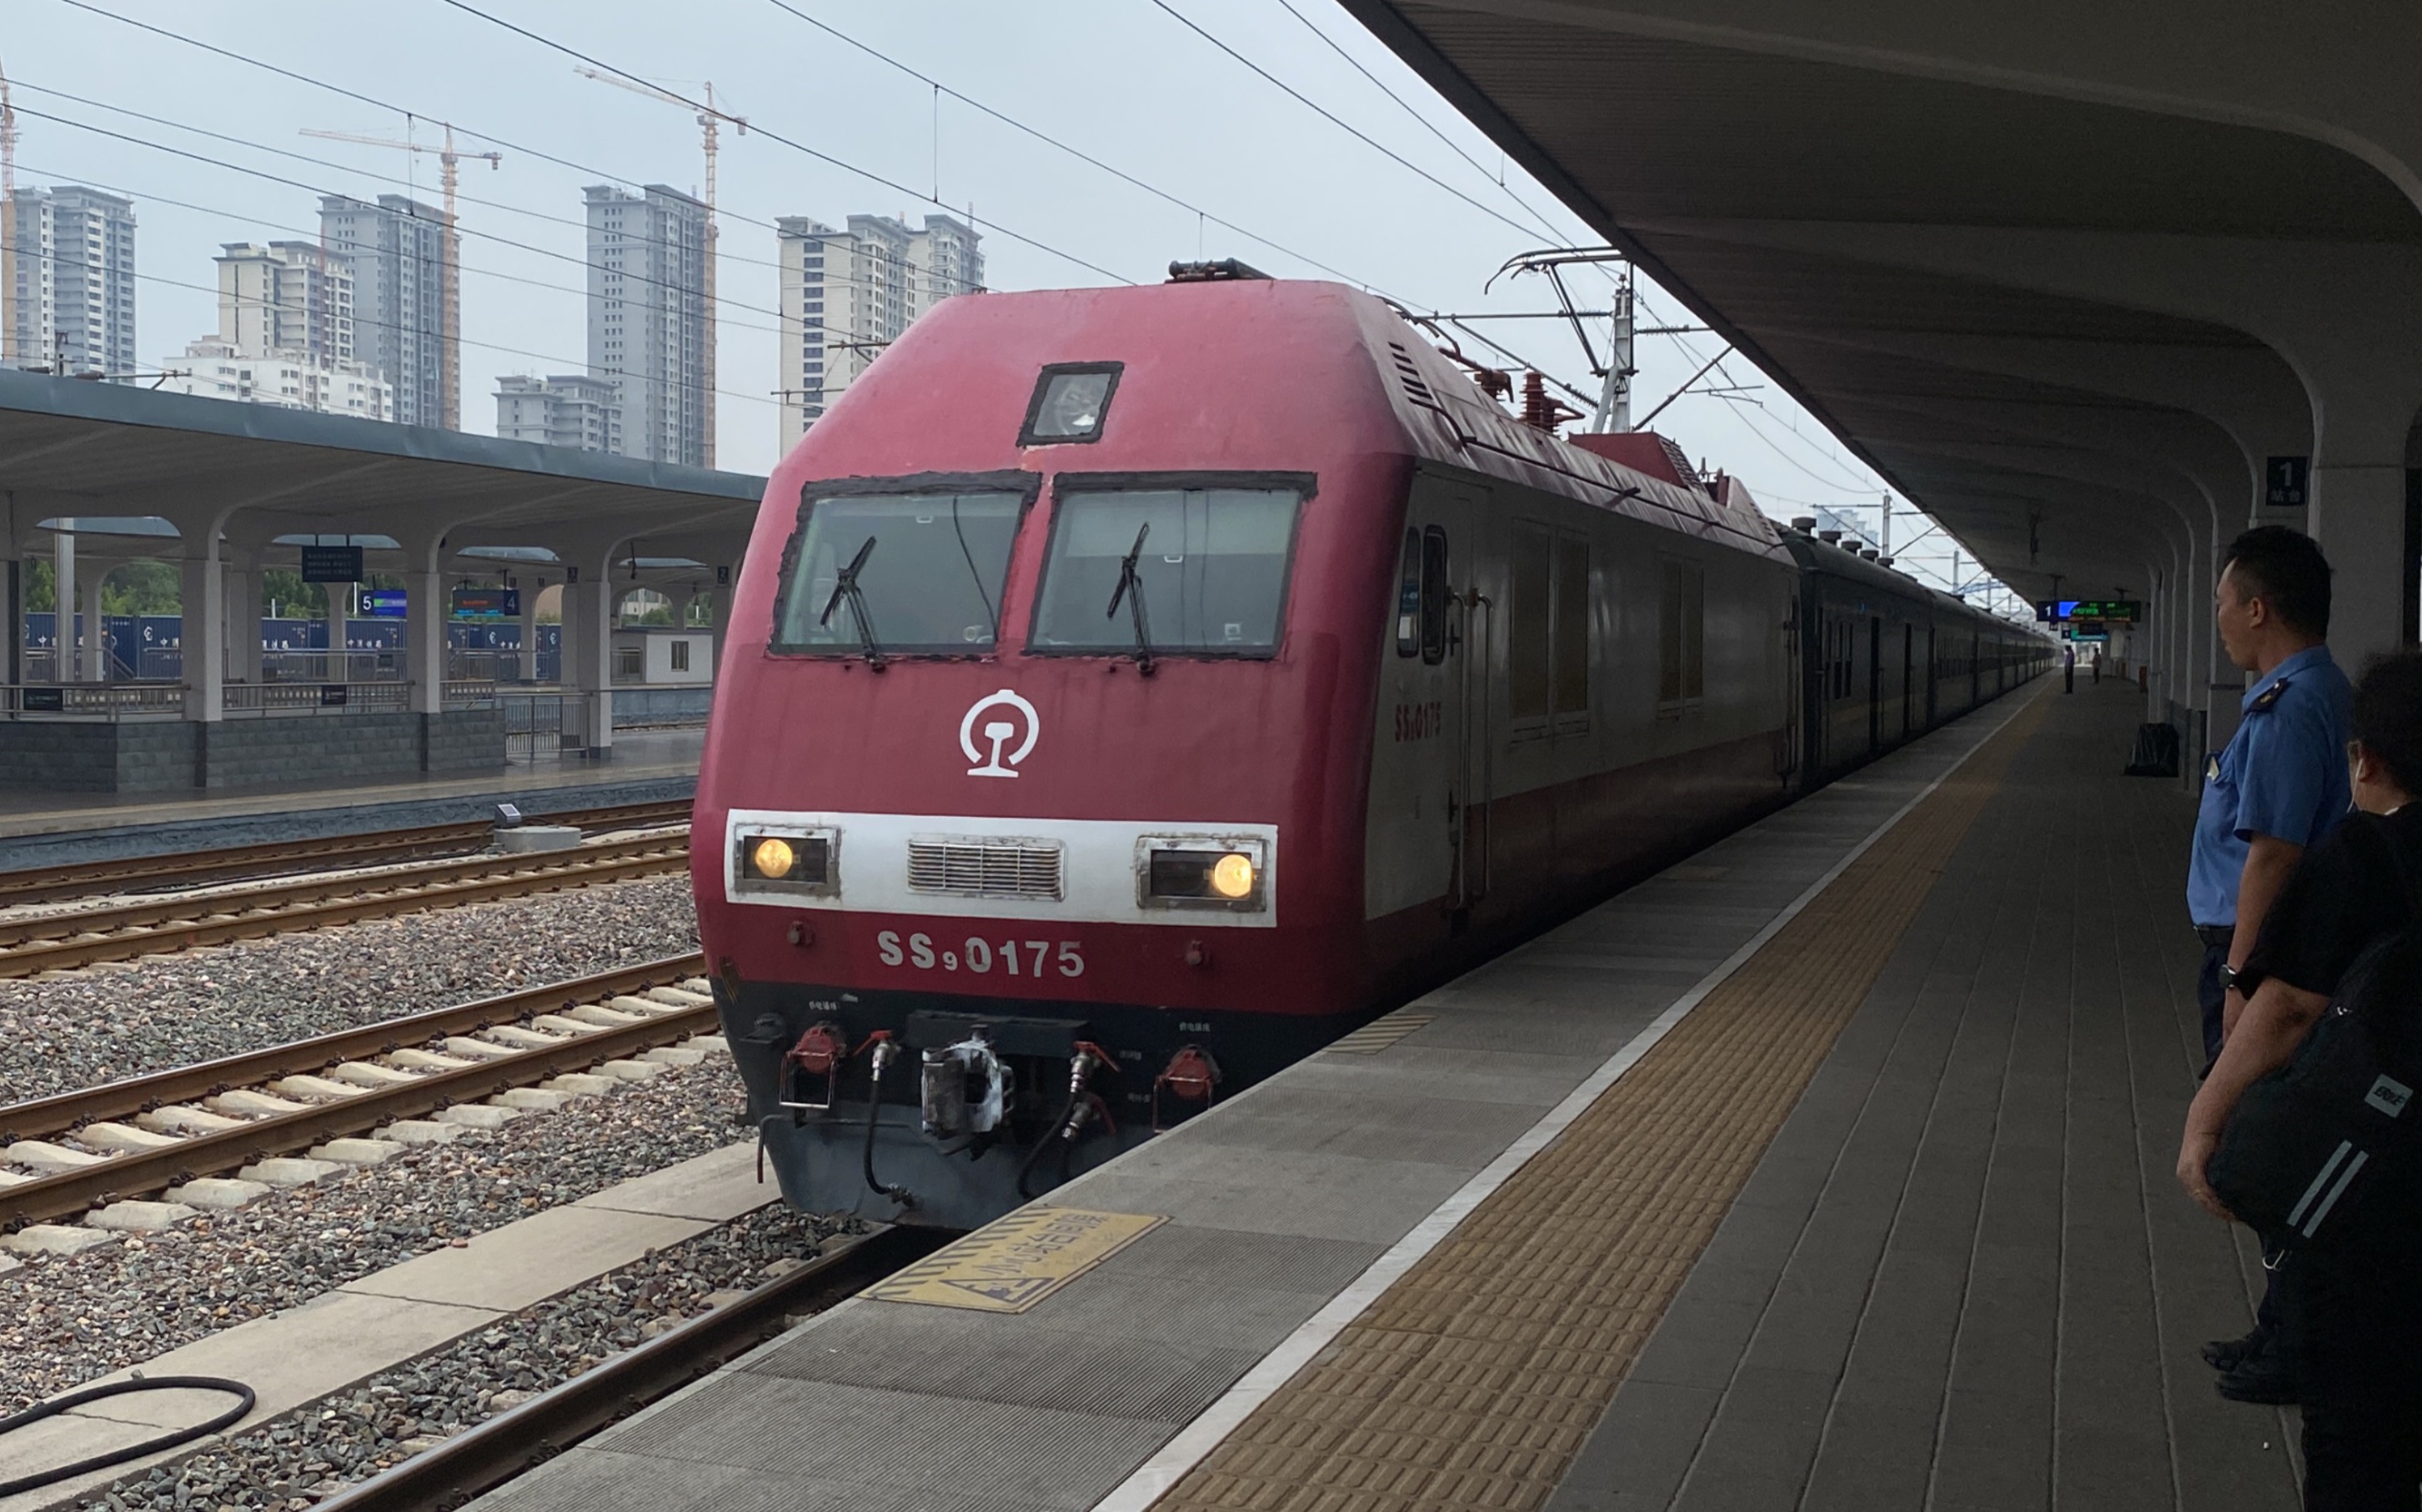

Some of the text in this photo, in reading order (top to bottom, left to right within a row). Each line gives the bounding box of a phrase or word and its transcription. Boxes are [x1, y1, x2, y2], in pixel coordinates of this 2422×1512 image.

[2279, 461, 2292, 487] 1
[363, 595, 372, 611] 5
[506, 595, 516, 610] 4
[2044, 604, 2052, 618] 1
